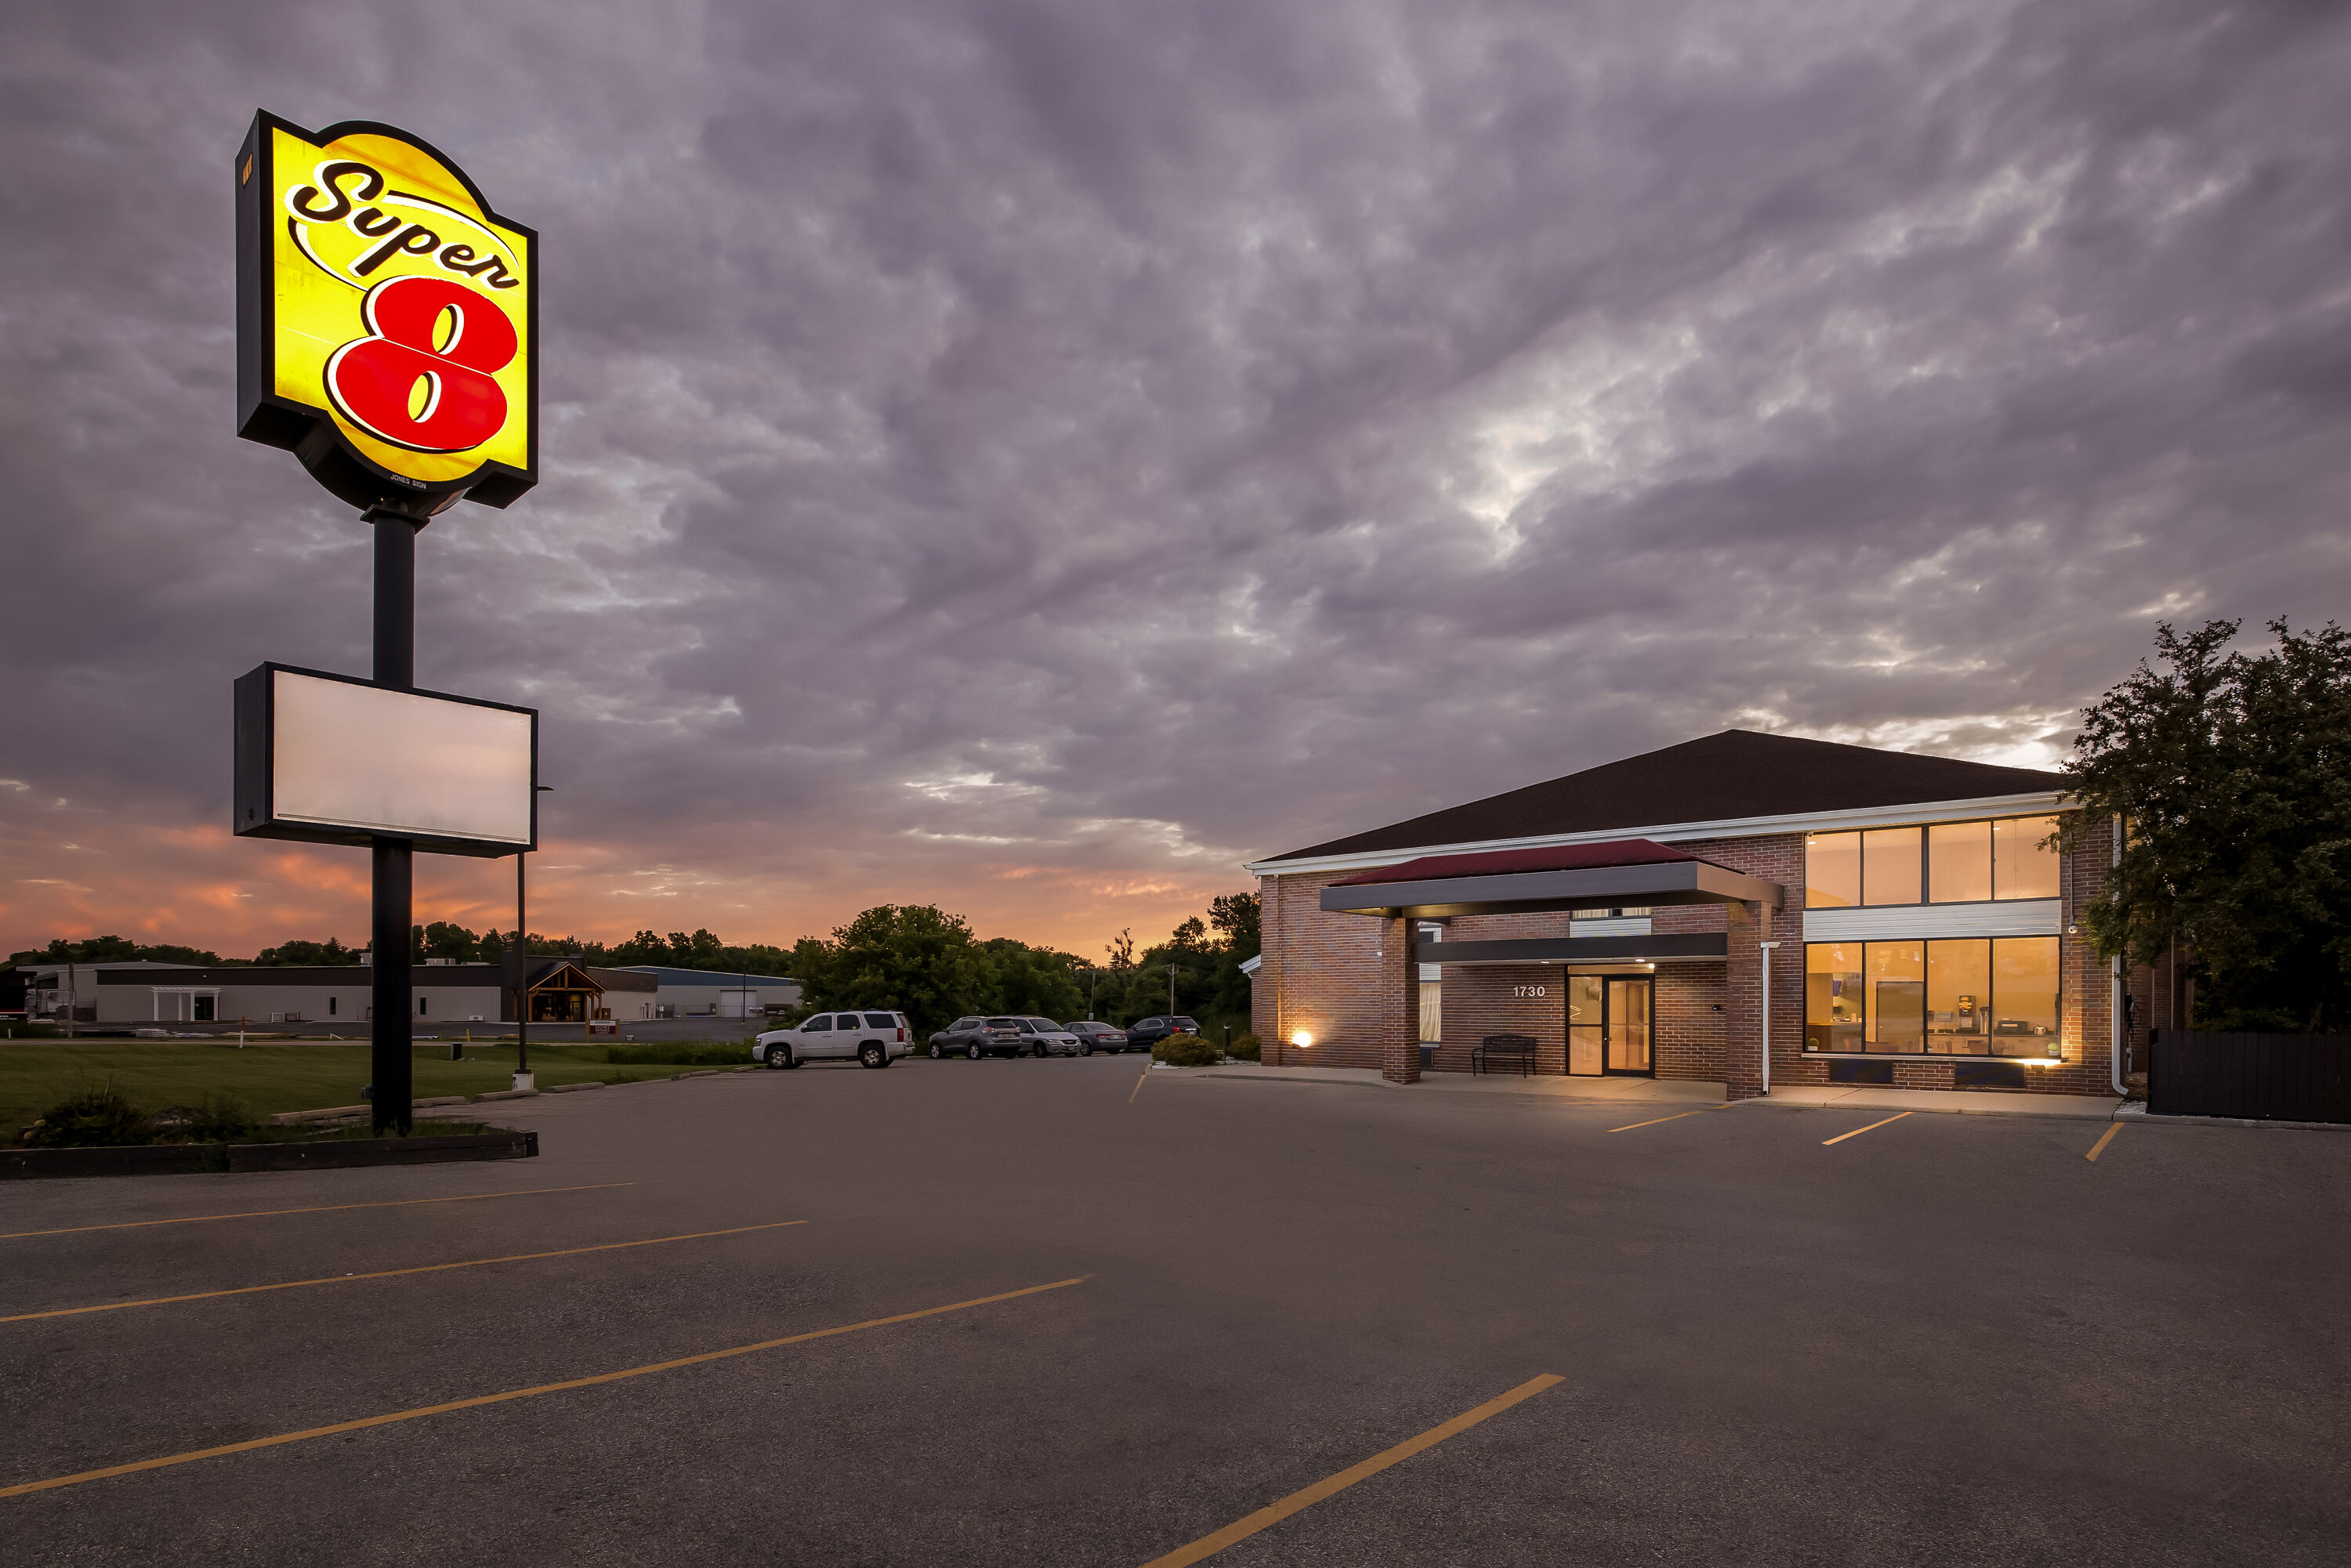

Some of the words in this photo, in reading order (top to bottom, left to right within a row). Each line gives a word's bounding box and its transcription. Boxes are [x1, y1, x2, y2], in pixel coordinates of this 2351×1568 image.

[288, 160, 520, 289] Super
[323, 275, 518, 454] 8
[390, 473, 410, 484] JONES
[412, 480, 426, 490] SIGN
[1513, 986, 1545, 997] 1730
